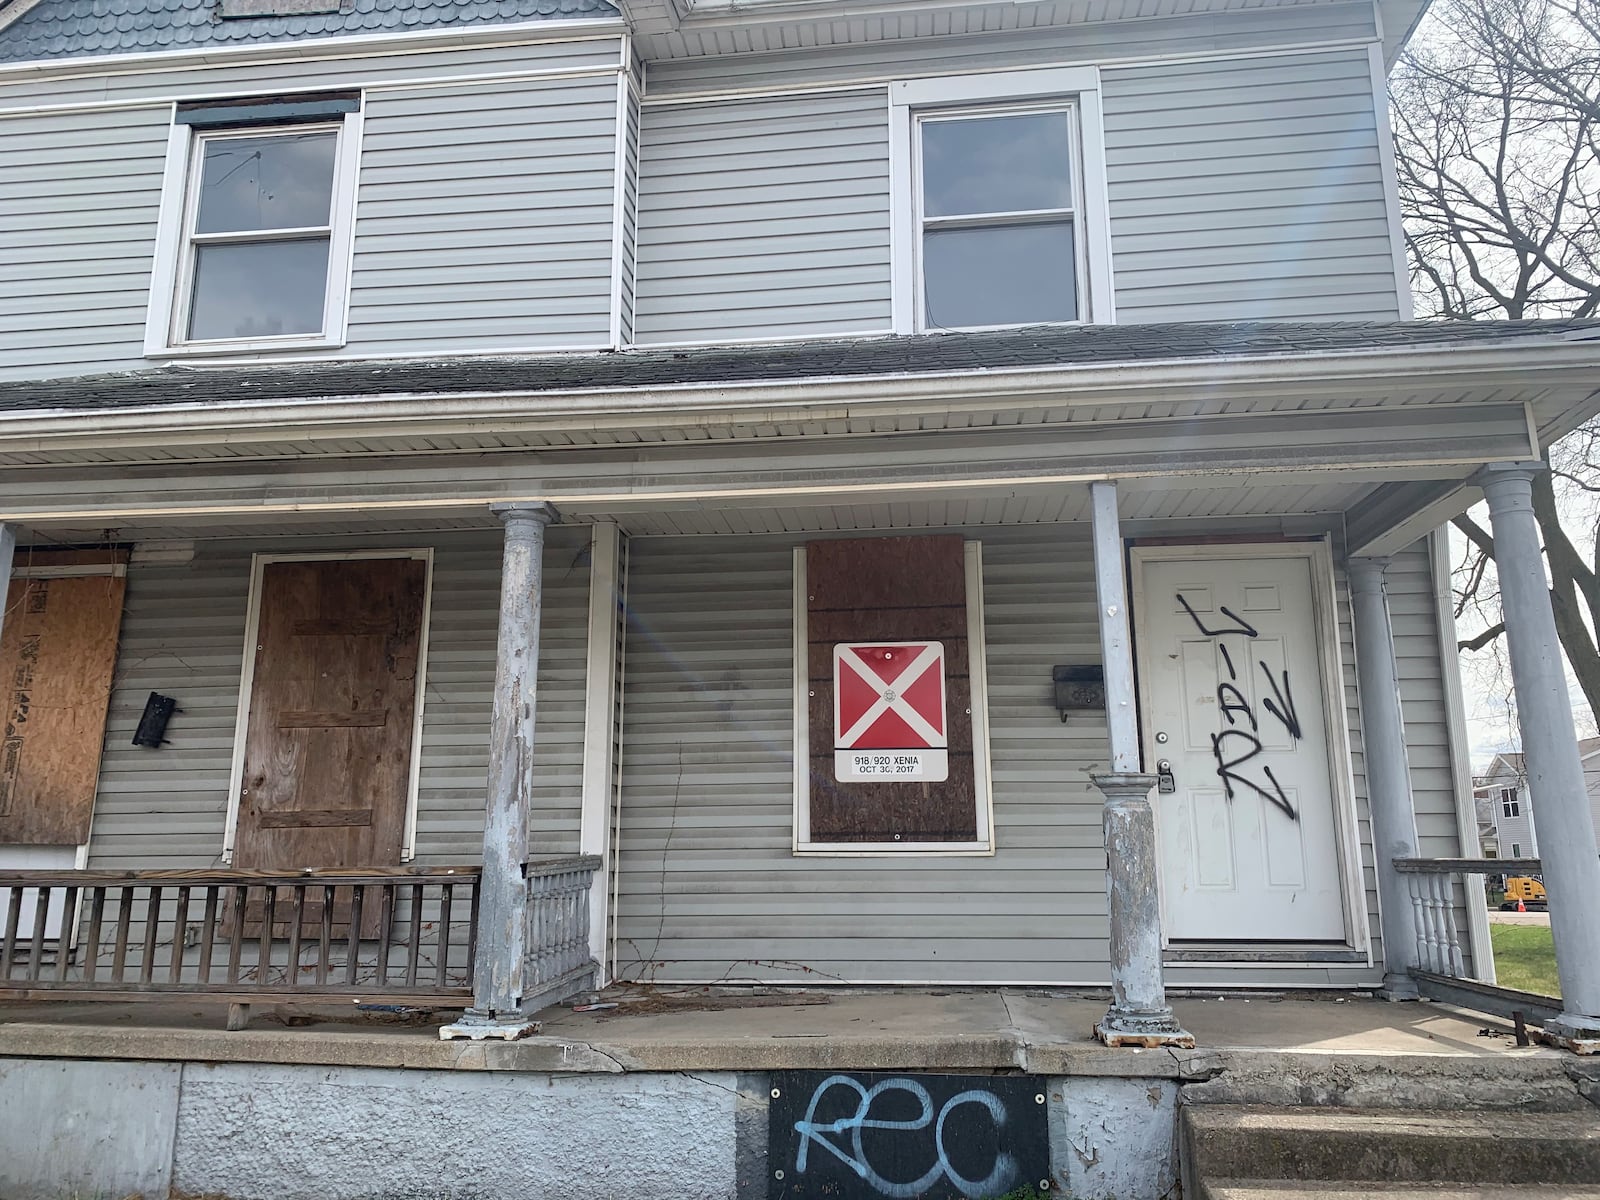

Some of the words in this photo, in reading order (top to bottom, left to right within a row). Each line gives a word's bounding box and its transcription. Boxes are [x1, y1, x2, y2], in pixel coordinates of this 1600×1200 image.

[17, 692, 31, 723] APA
[854, 756, 891, 766] 918/920
[893, 756, 919, 765] XENIA
[859, 765, 877, 773] OCT
[895, 765, 914, 773] 2017
